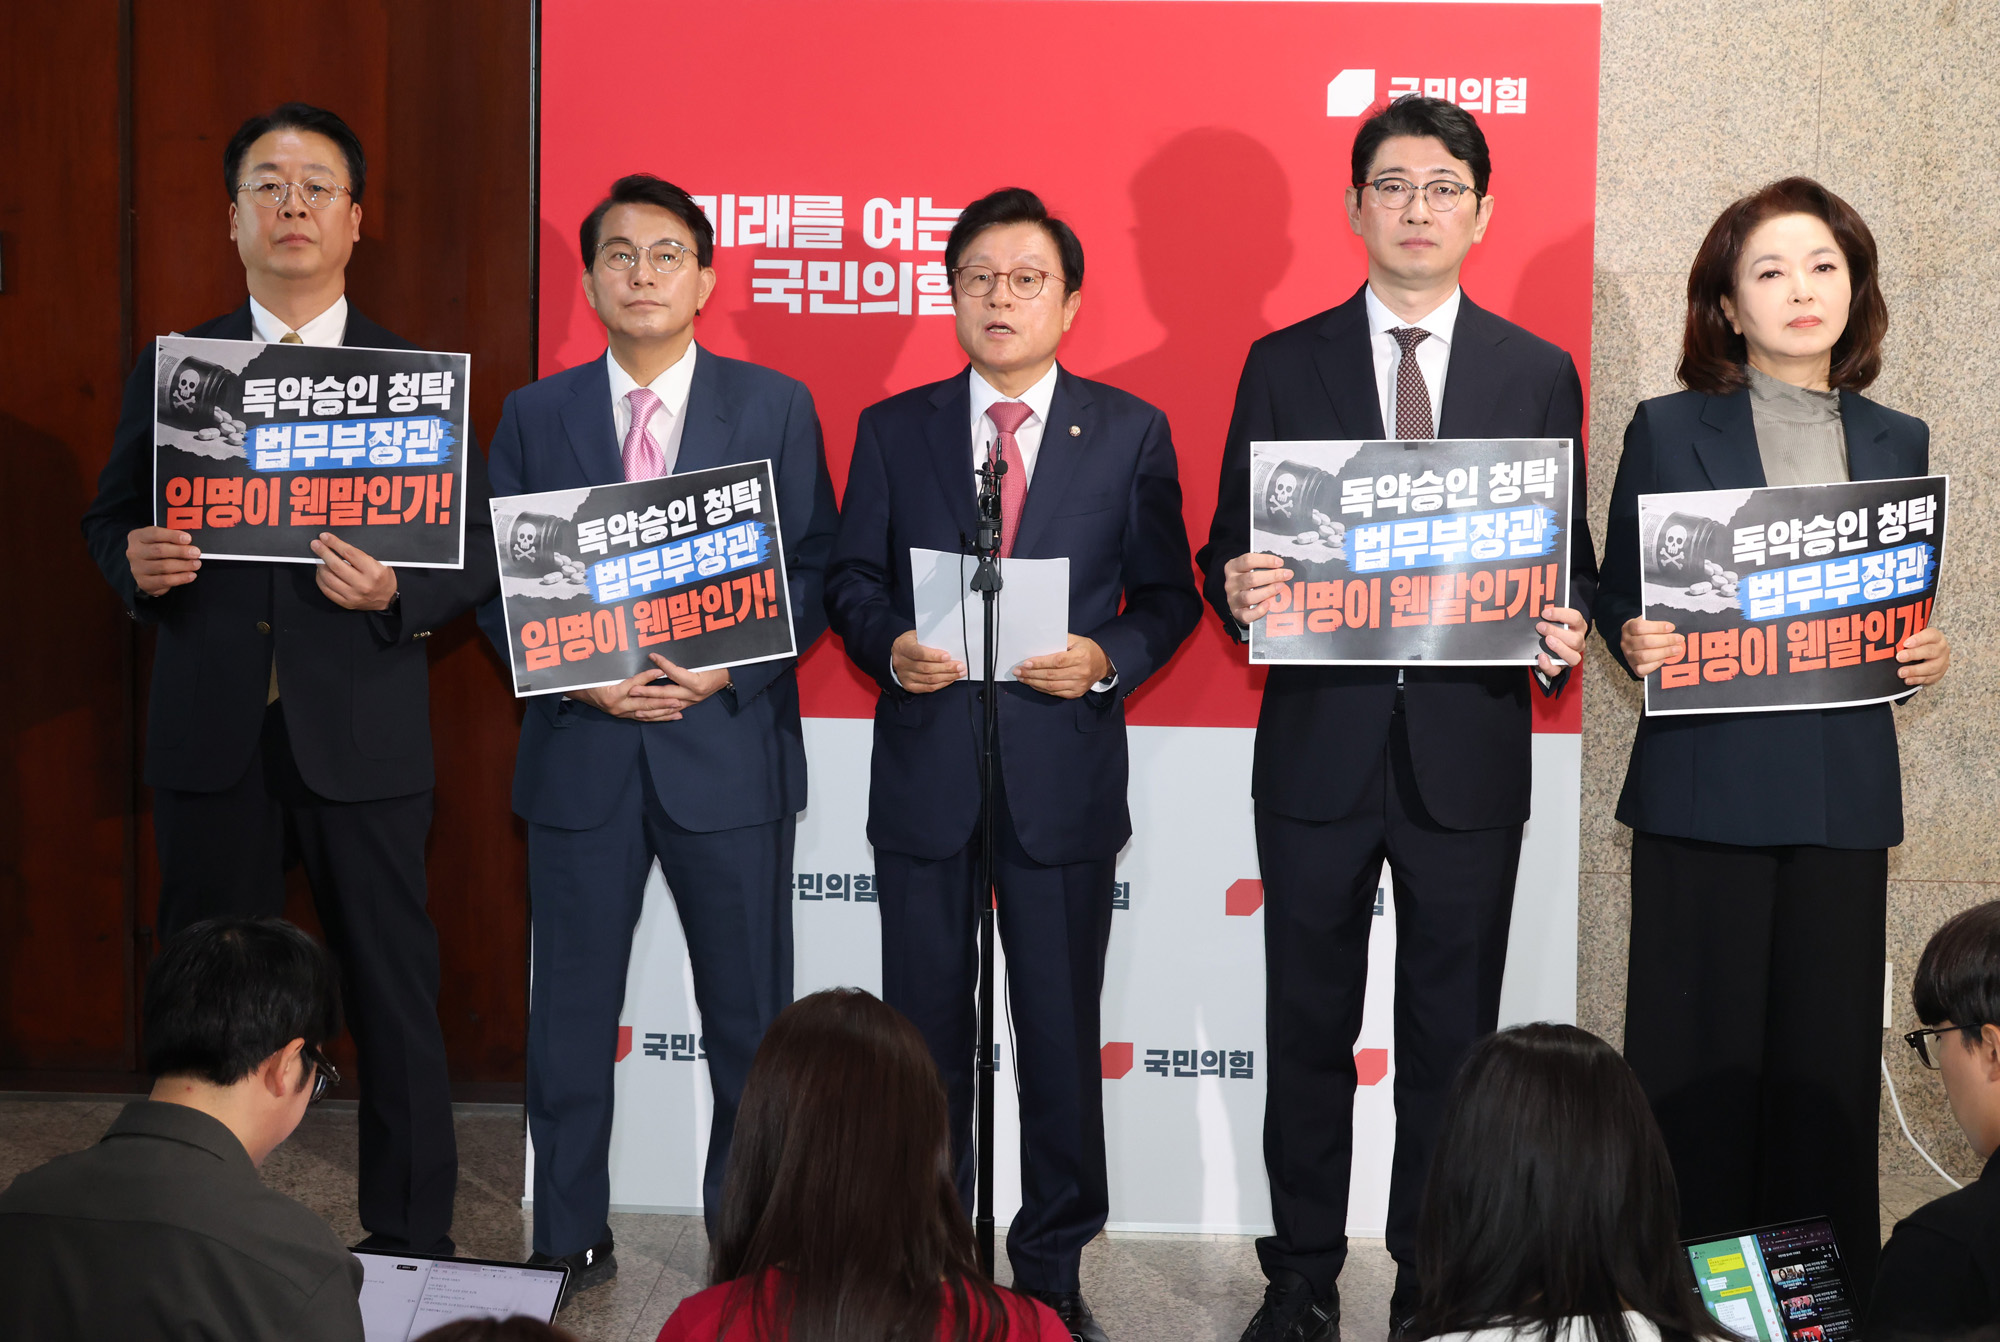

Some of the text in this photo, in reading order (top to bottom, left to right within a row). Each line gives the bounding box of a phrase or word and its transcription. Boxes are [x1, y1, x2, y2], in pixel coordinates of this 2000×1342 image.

[690, 194, 968, 250] 미래를 여는
[752, 259, 957, 316] 국민의힘
[242, 371, 455, 418] 독약승인 청탁
[255, 419, 444, 470] 법무부장관
[165, 473, 453, 530] 임명이 웬말인가!
[577, 497, 698, 555] 독약승인
[703, 477, 762, 526] 청탁
[1340, 457, 1559, 518] 독약승인 청탁
[1354, 508, 1548, 571] 법무부장관
[1732, 494, 1937, 566] 독약승인 청탁
[594, 522, 760, 603] 법무부장관
[1748, 544, 1928, 619] 법무부장관
[520, 568, 779, 672] 임명이 웬말인가!
[1265, 563, 1558, 637] 임명이 웬말인가!
[1661, 625, 1778, 689] 임명이
[792, 873, 878, 902] 민의힘
[1144, 1049, 1254, 1079] 국민의힘
